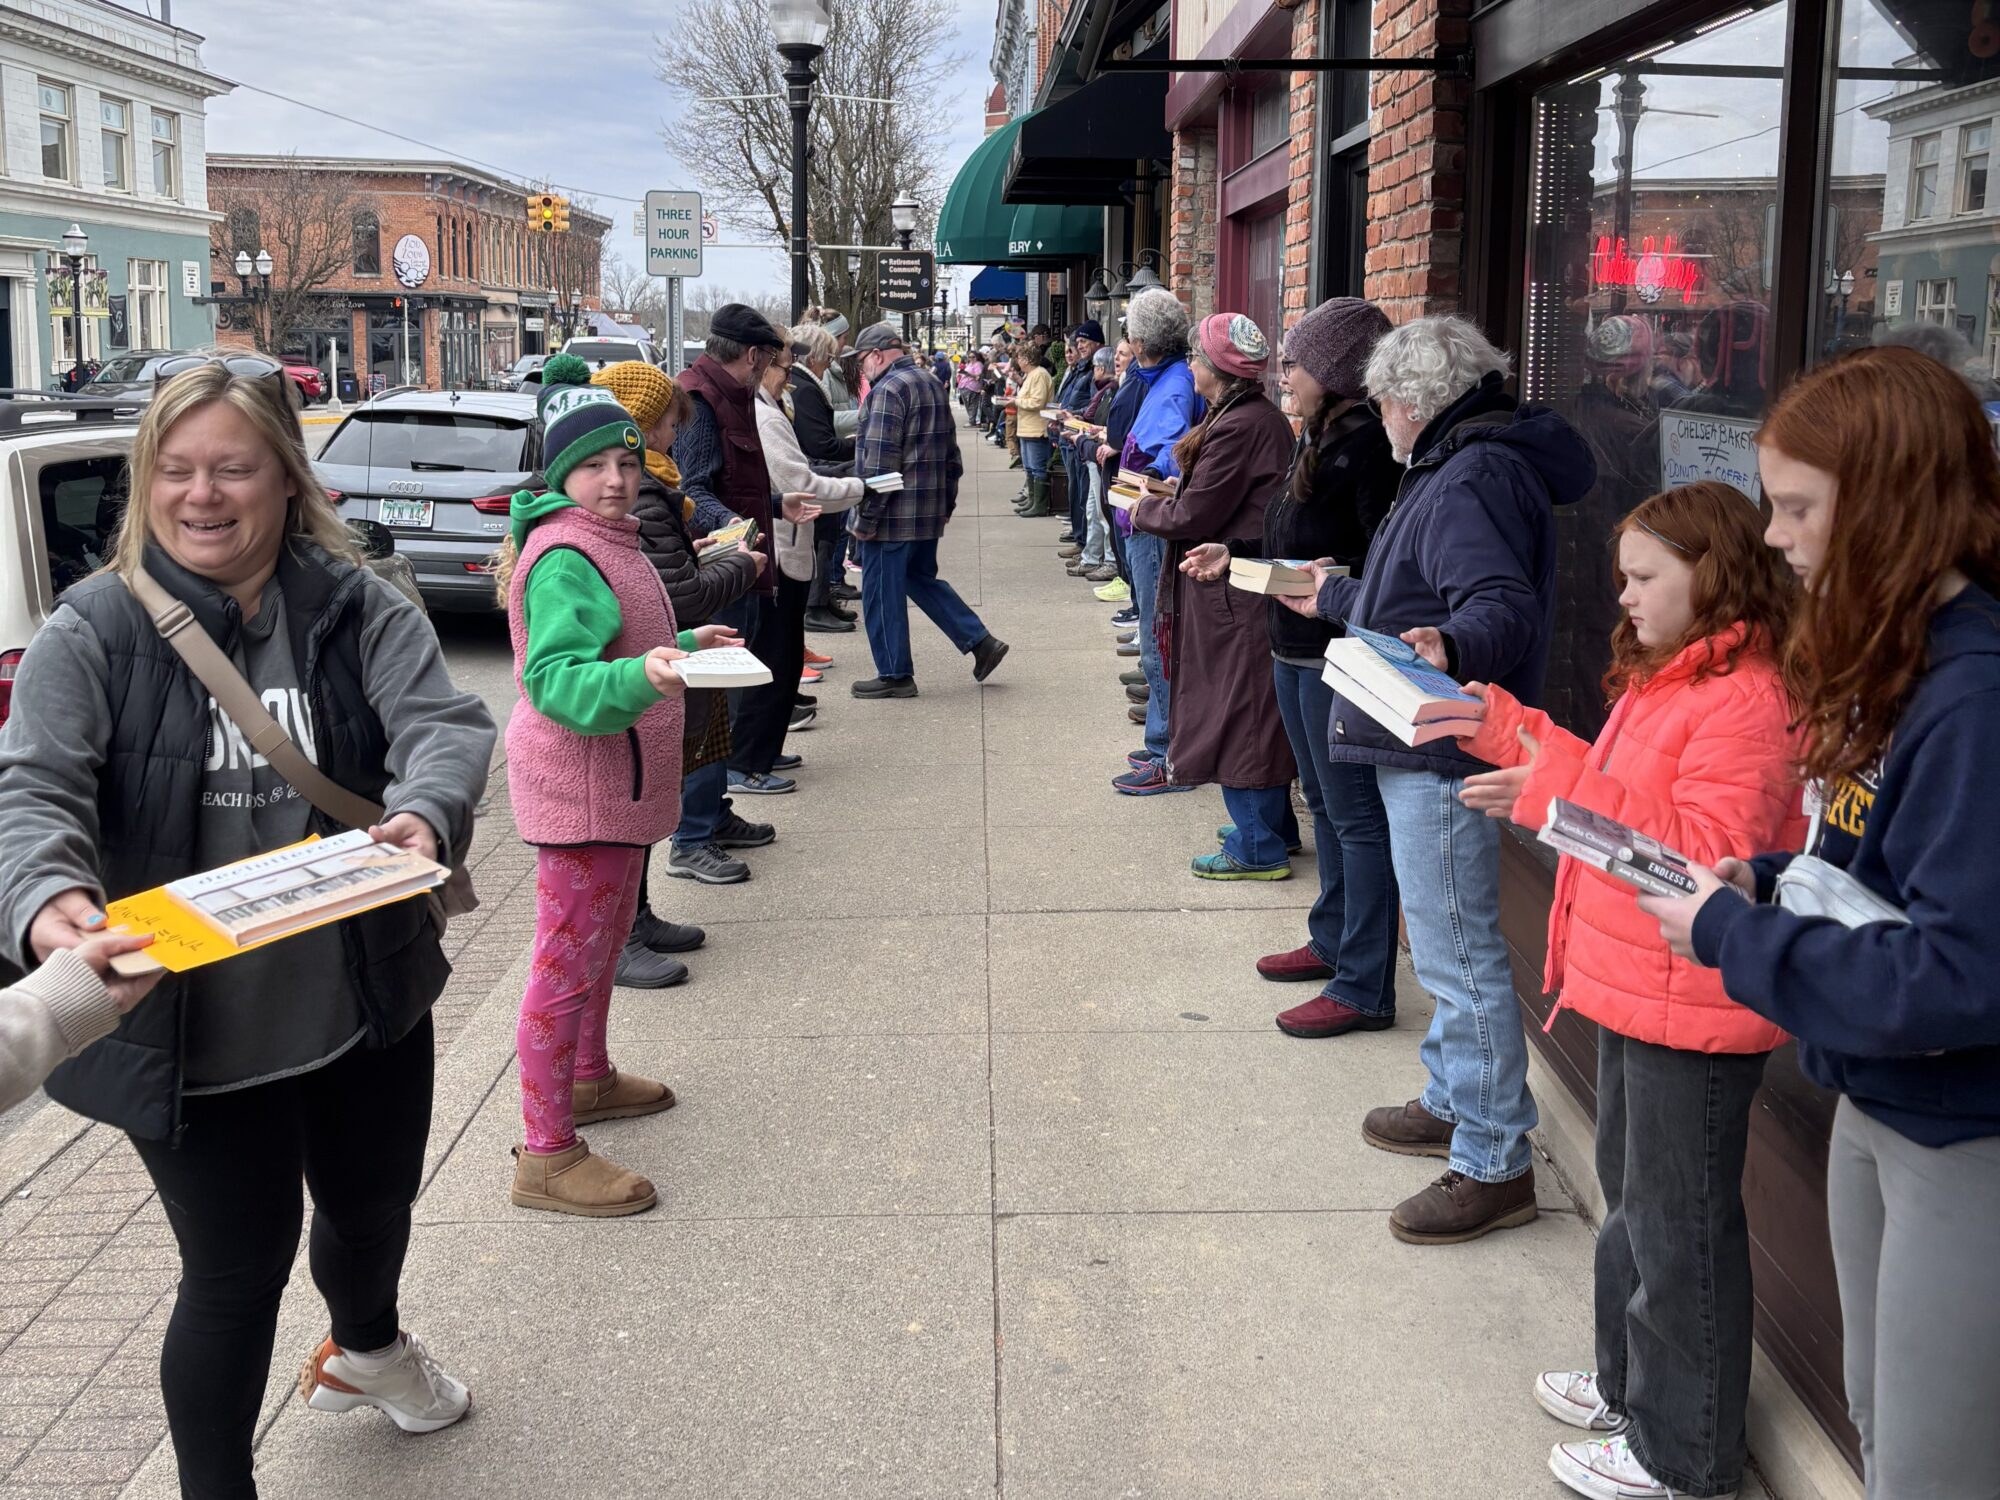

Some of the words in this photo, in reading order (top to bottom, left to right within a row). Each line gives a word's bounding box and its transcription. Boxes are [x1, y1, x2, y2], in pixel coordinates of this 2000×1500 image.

[655, 208, 692, 220] THREE
[658, 228, 689, 240] HOUR
[650, 247, 698, 259] PARKING
[889, 258, 921, 266] Retirement
[889, 266, 922, 274] Community
[889, 279, 912, 287] Parking
[889, 291, 917, 300] Shopping
[1677, 418, 1717, 440] CHELSEA
[1715, 465, 1749, 487] COFFEE
[1648, 861, 1686, 886] ENDLESS
